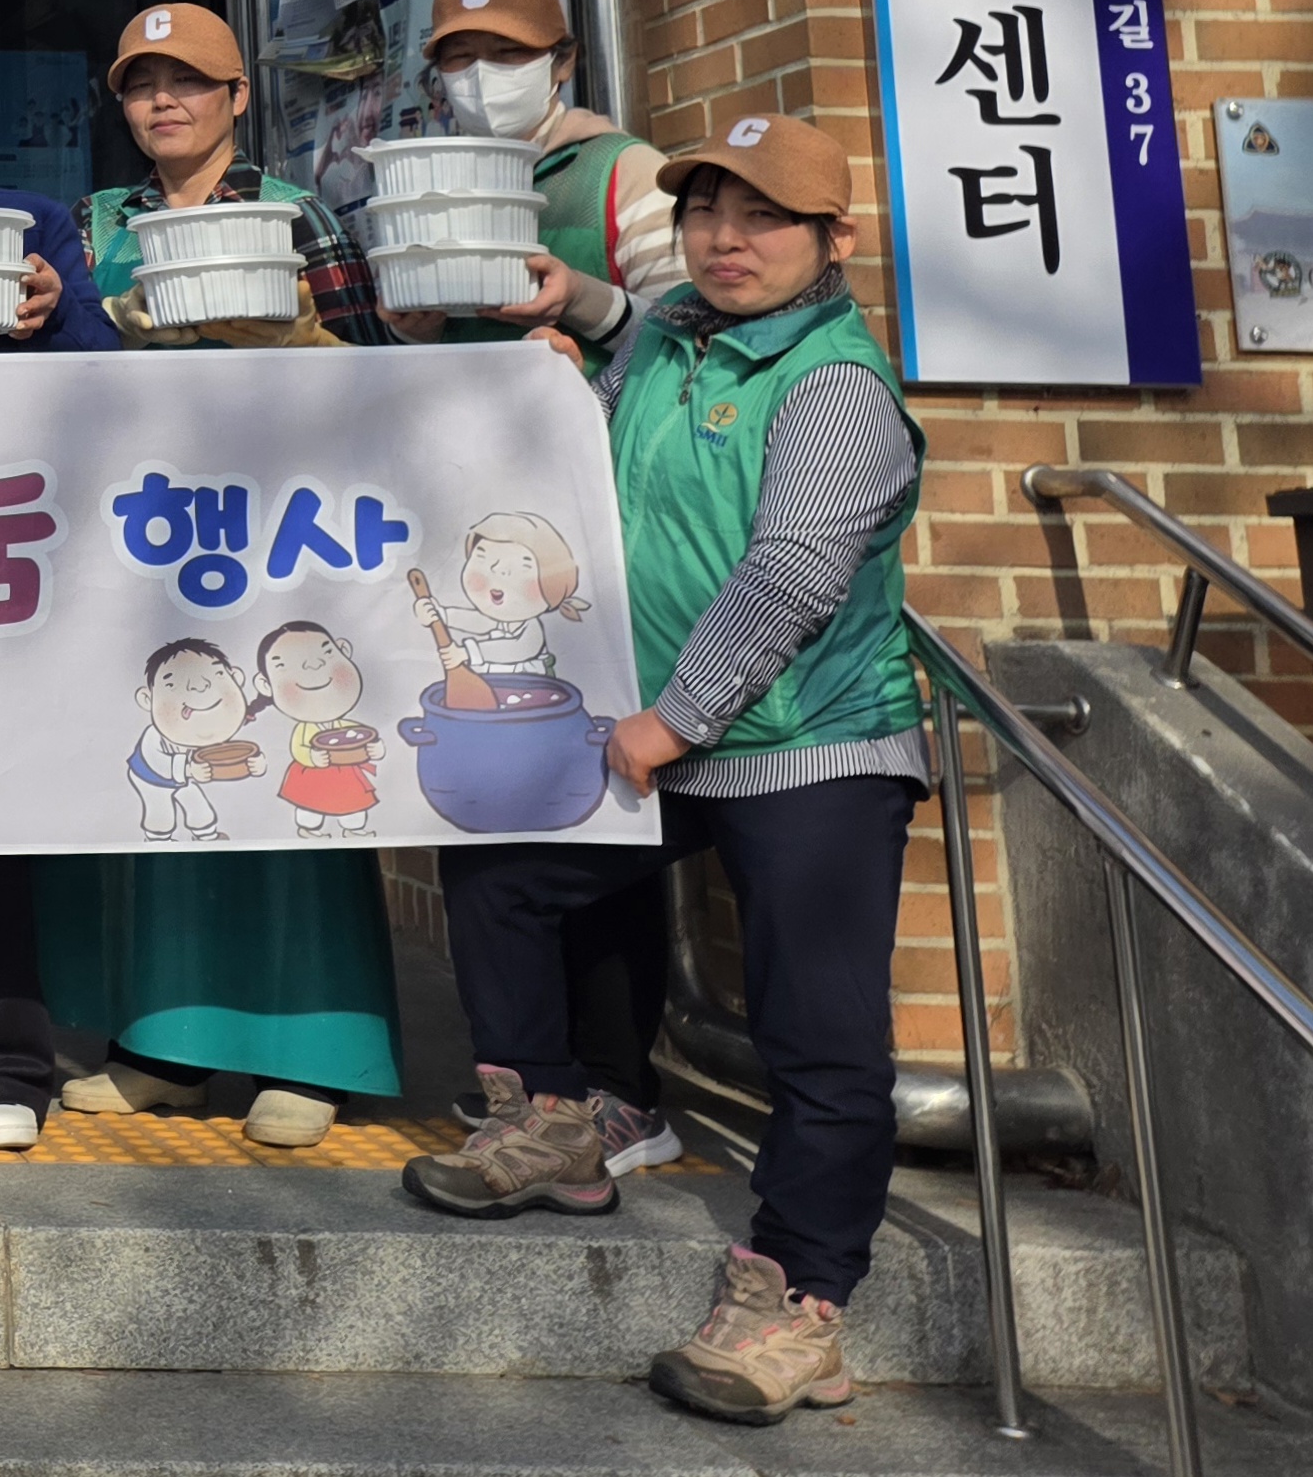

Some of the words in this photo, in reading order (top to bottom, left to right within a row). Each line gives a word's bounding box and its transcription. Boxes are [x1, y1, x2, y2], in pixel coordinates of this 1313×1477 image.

[144, 9, 172, 42] C
[726, 117, 771, 148] C
[1125, 71, 1155, 166] 37
[111, 472, 410, 609] 행사
